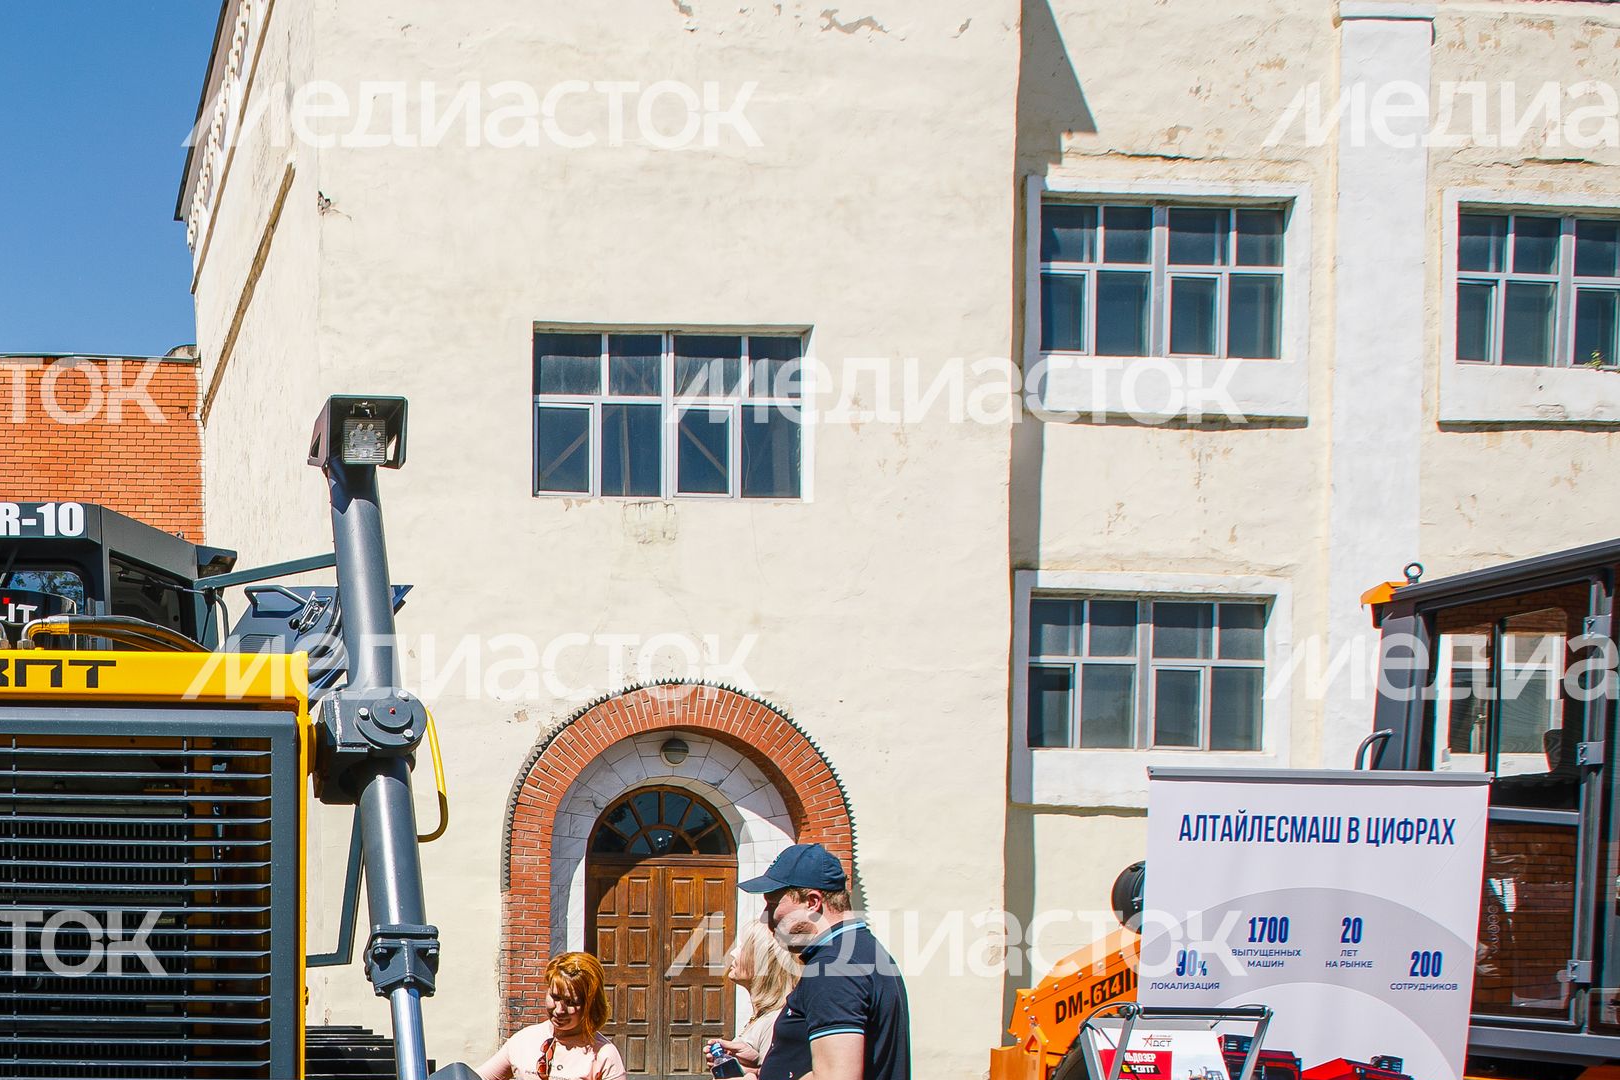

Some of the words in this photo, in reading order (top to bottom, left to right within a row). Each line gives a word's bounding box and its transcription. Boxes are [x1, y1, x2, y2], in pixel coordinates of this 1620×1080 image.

[1178, 809, 1340, 844] АЛТАЙЛЕСМАШ
[1346, 816, 1360, 844] В
[1365, 817, 1456, 847] ЦИФРАХ
[1247, 916, 1290, 943] 1700
[1340, 917, 1363, 944] 20
[1231, 948, 1302, 958] ВЫПУЩЕННЫХ
[1340, 949, 1358, 957] ЛЕТ
[1175, 949, 1207, 977] 90%
[1247, 960, 1285, 968] МАШИН
[1325, 960, 1338, 968] НА
[1340, 960, 1373, 968] РЫНКЕ
[1409, 951, 1443, 978] 200
[1150, 982, 1220, 991] ЛОКАЛИЗАЦИЯ
[1389, 983, 1458, 991] СОТРУДНИКОВ
